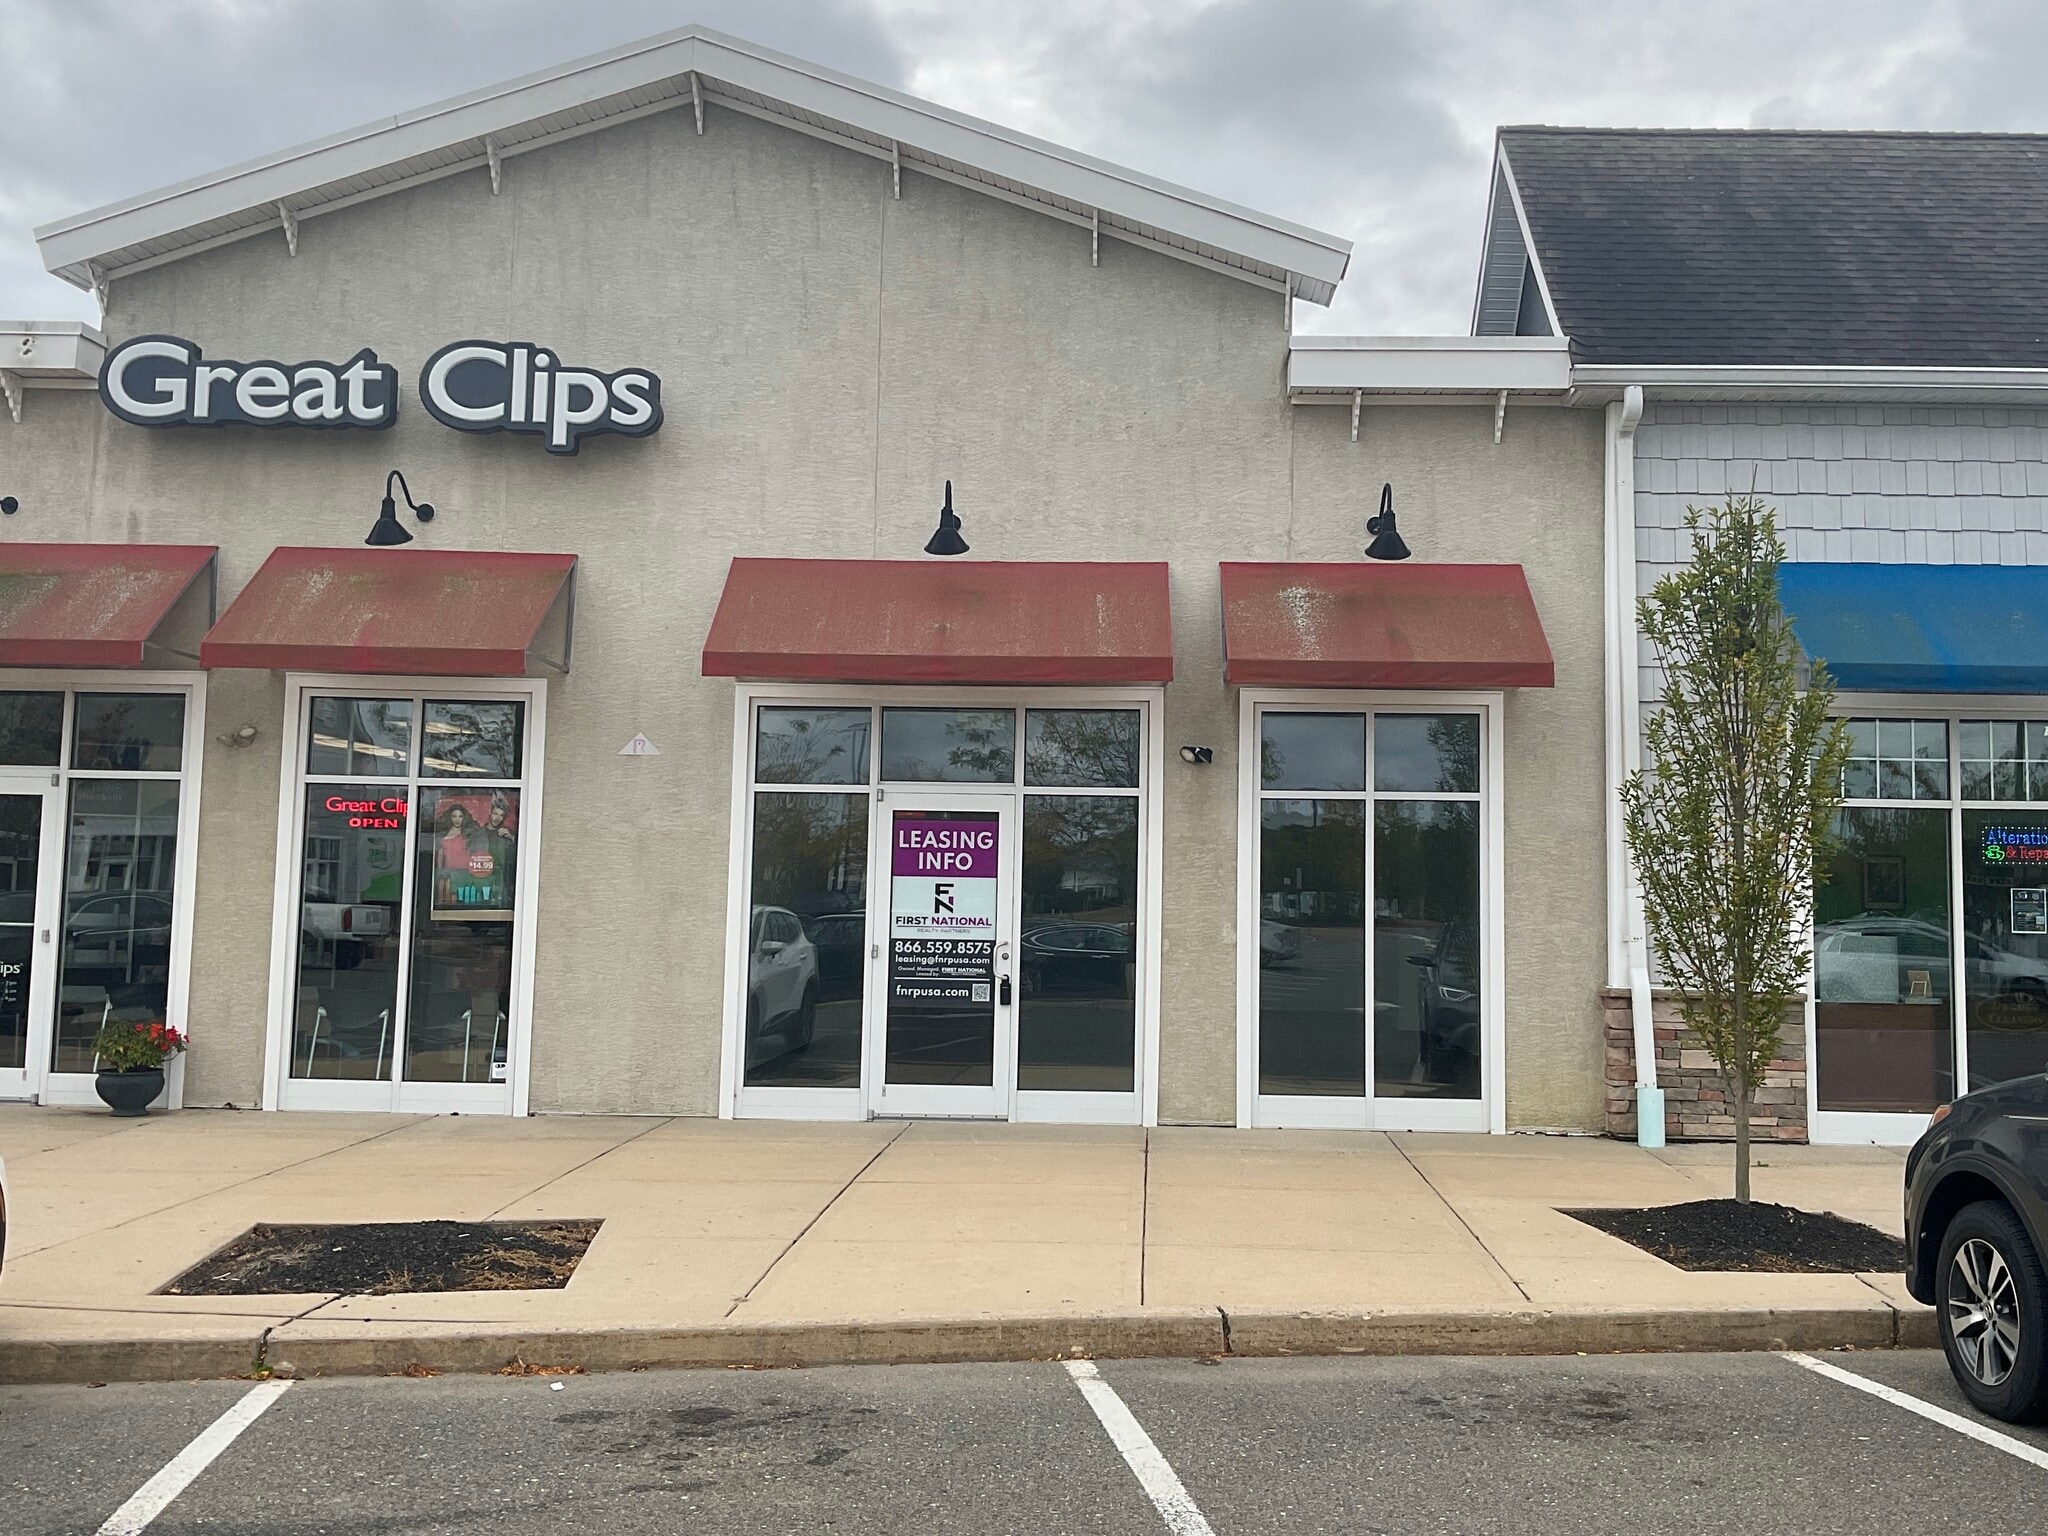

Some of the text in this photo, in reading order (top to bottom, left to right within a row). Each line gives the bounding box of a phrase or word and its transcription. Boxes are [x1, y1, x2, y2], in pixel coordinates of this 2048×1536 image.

[106, 340, 653, 446] Great Clips
[325, 796, 377, 812] Great
[348, 817, 398, 828] OPEN
[899, 829, 994, 850] LEASING
[2006, 845, 2017, 858] &
[918, 851, 973, 871] INFO
[895, 916, 992, 926] FIRST NATIONAL
[895, 940, 992, 954] 866.559.8575
[895, 954, 990, 965] leasing@fnrpusa.com
[896, 984, 969, 999] fnrpusa.com
